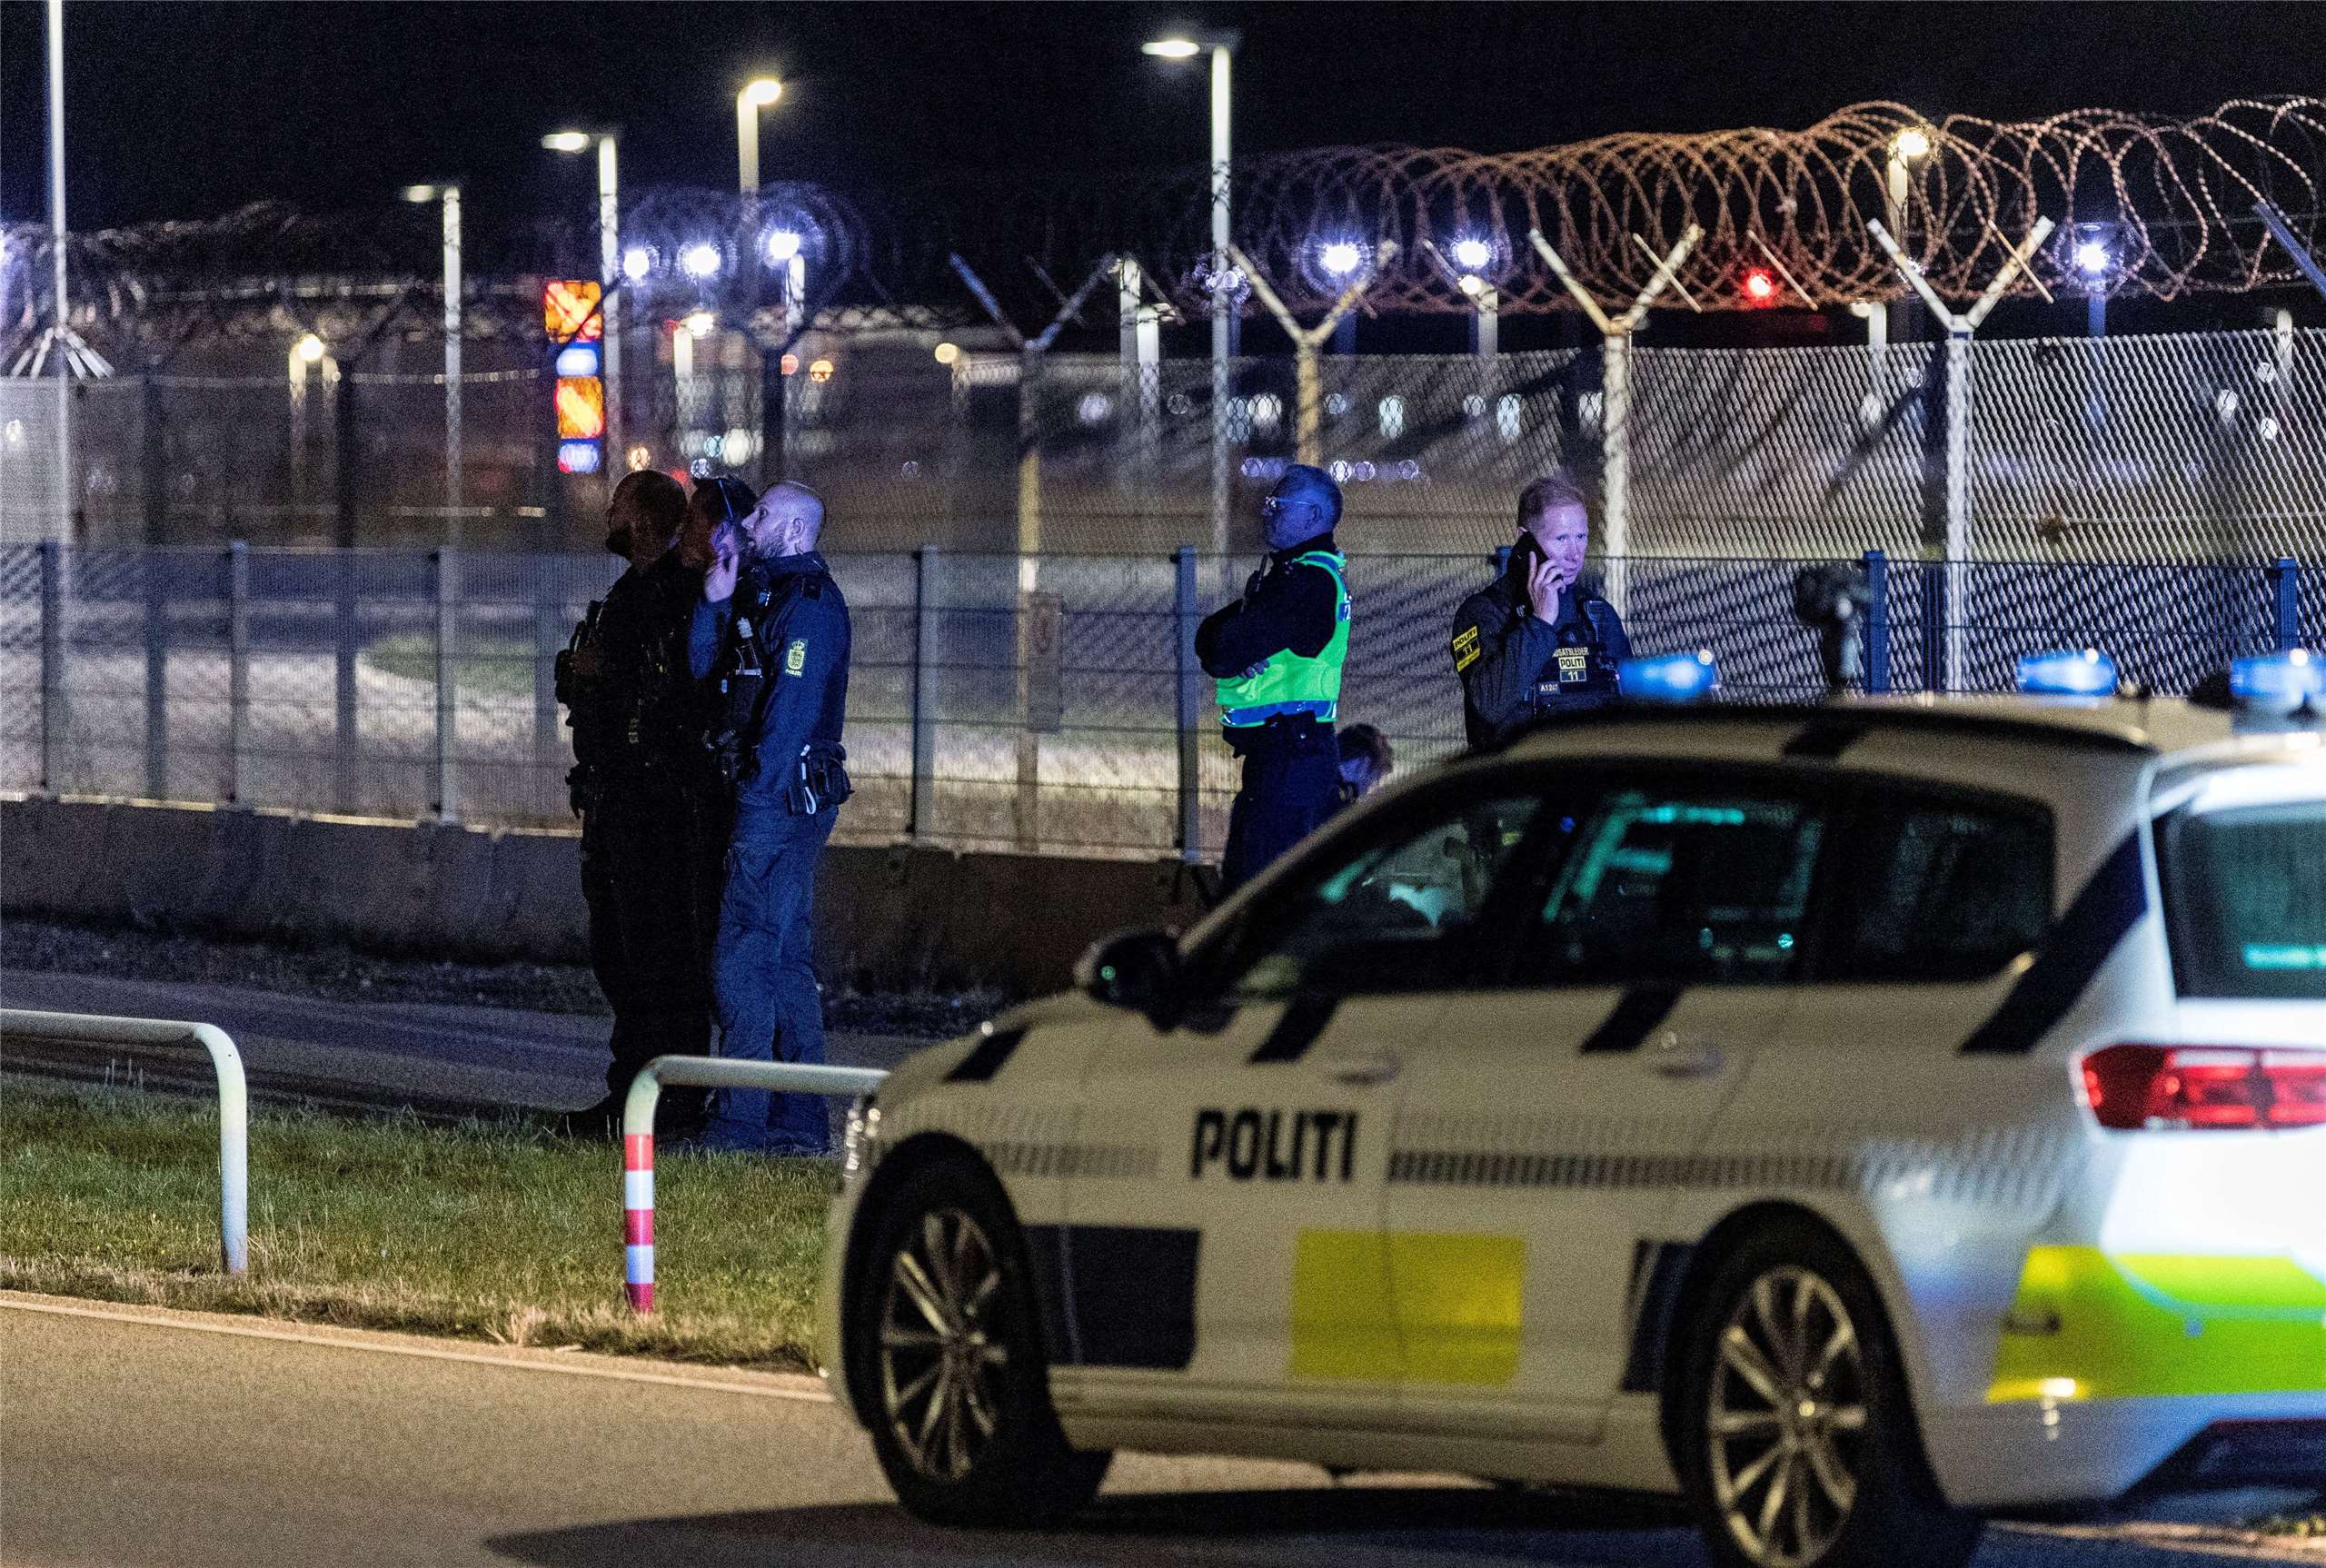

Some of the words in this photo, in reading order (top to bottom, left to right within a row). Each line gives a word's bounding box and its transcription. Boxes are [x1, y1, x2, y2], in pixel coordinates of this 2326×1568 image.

[1455, 628, 1476, 648] POLITI
[1463, 642, 1473, 655] 11
[1552, 647, 1589, 658] DSATSLEDER
[1560, 658, 1585, 668] POLITI
[785, 669, 801, 677] POLITI
[1567, 670, 1579, 680] 11
[1191, 1109, 1358, 1182] POLITI
